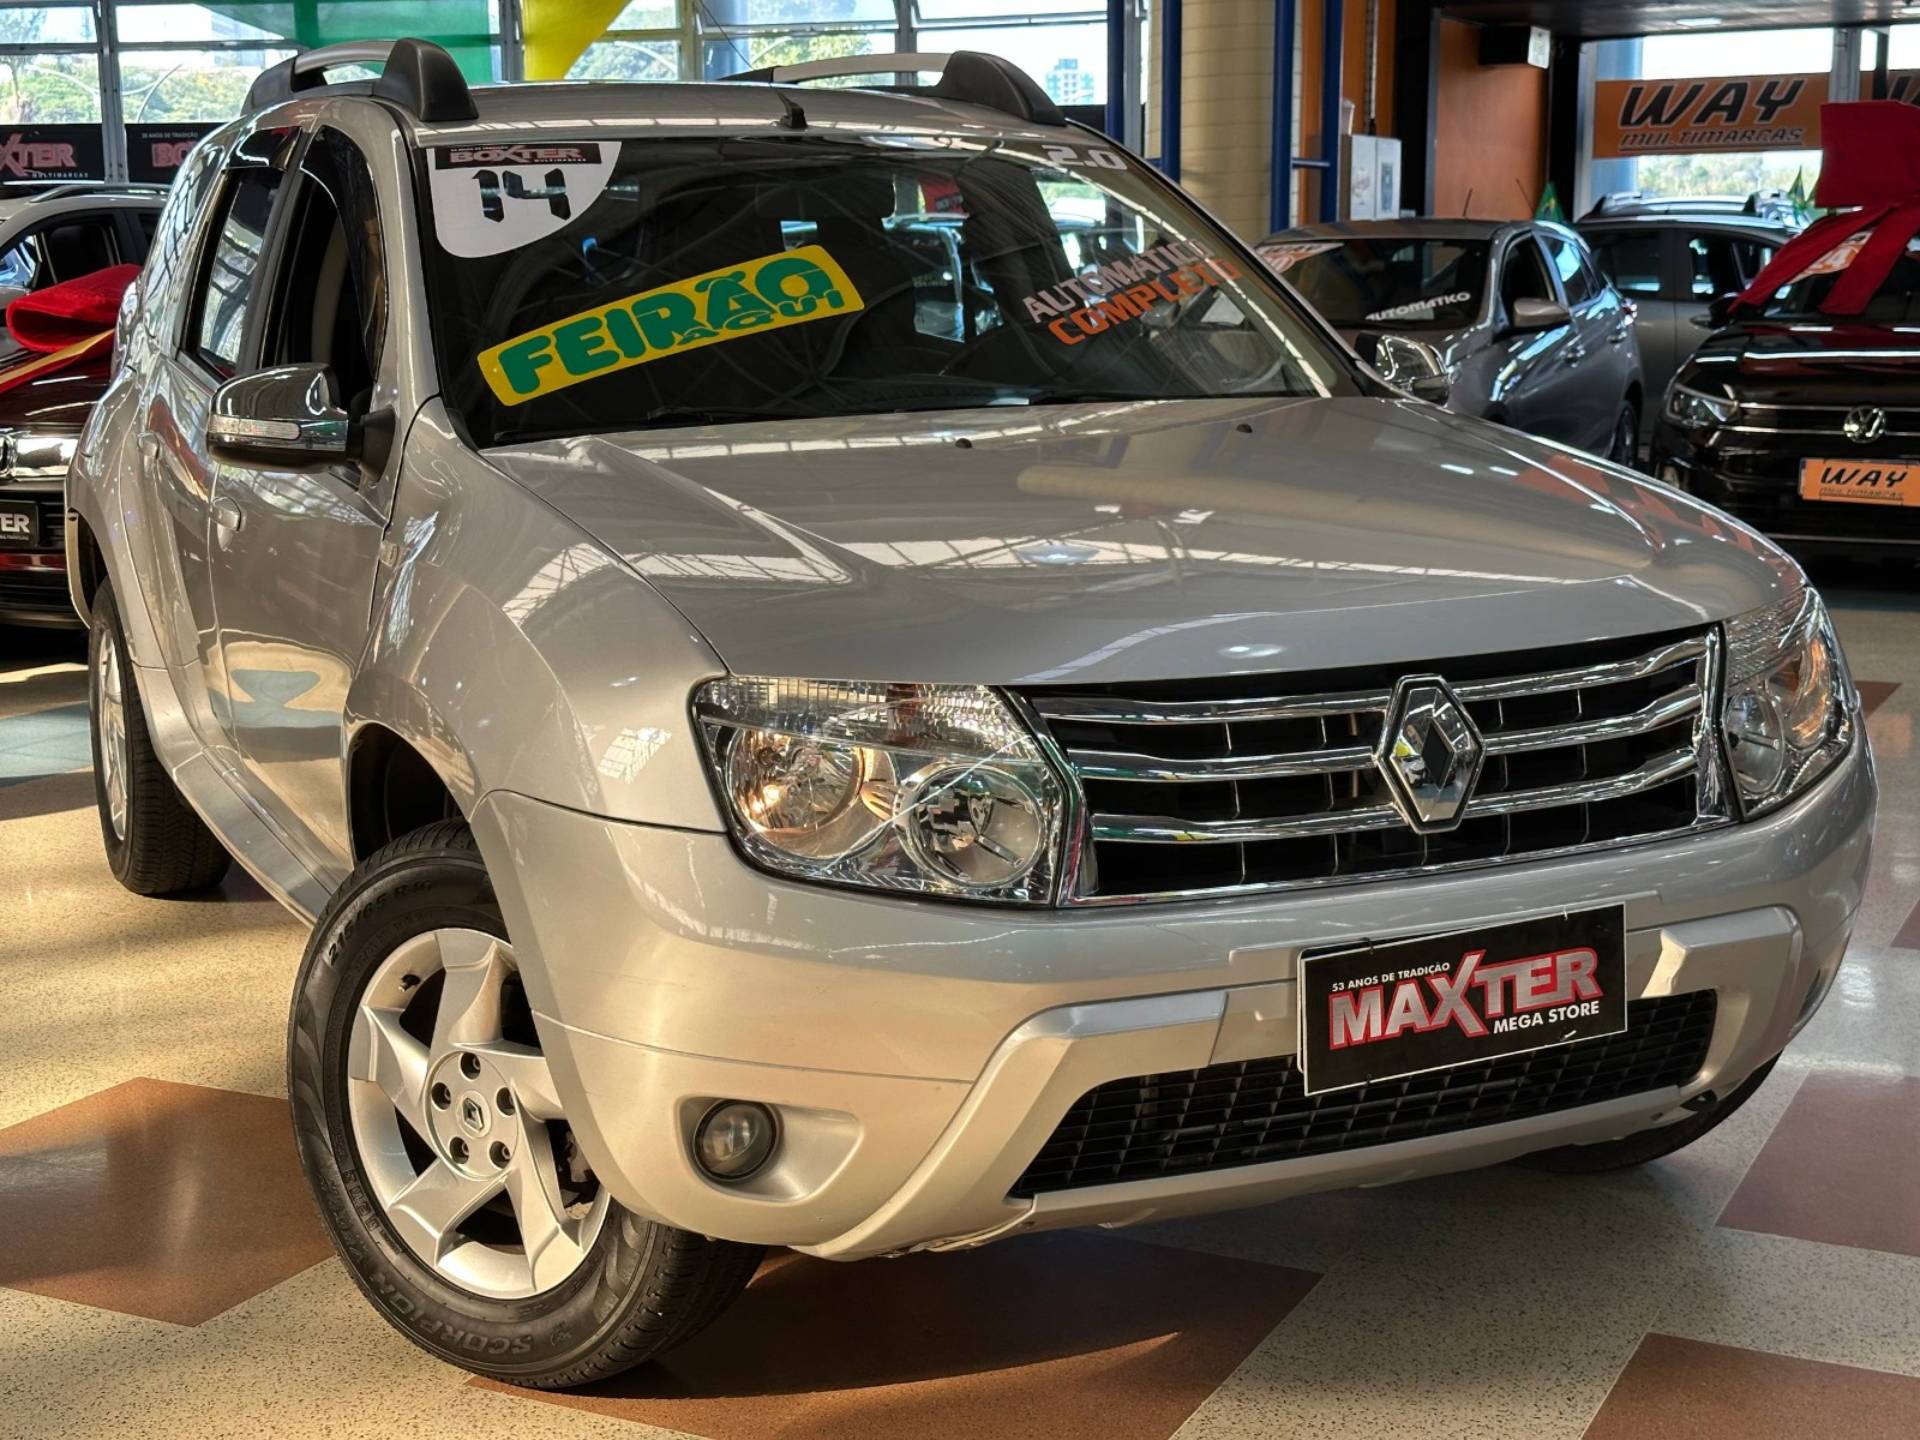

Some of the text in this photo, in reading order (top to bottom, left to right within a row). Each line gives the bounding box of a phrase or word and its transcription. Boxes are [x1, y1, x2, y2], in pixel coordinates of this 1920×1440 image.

[1619, 79, 1804, 128] WAY
[450, 145, 584, 164] BOXTER
[1041, 144, 1128, 170] 2.0
[472, 168, 571, 223] 14
[498, 257, 833, 394] FEIRÃO
[1821, 467, 1908, 488] WAY
[1332, 961, 1451, 992] 53 ANOS DE TRADIÇÃO
[1329, 948, 1604, 1050] MAXTER
[1493, 1000, 1600, 1034] MEGA STORE
